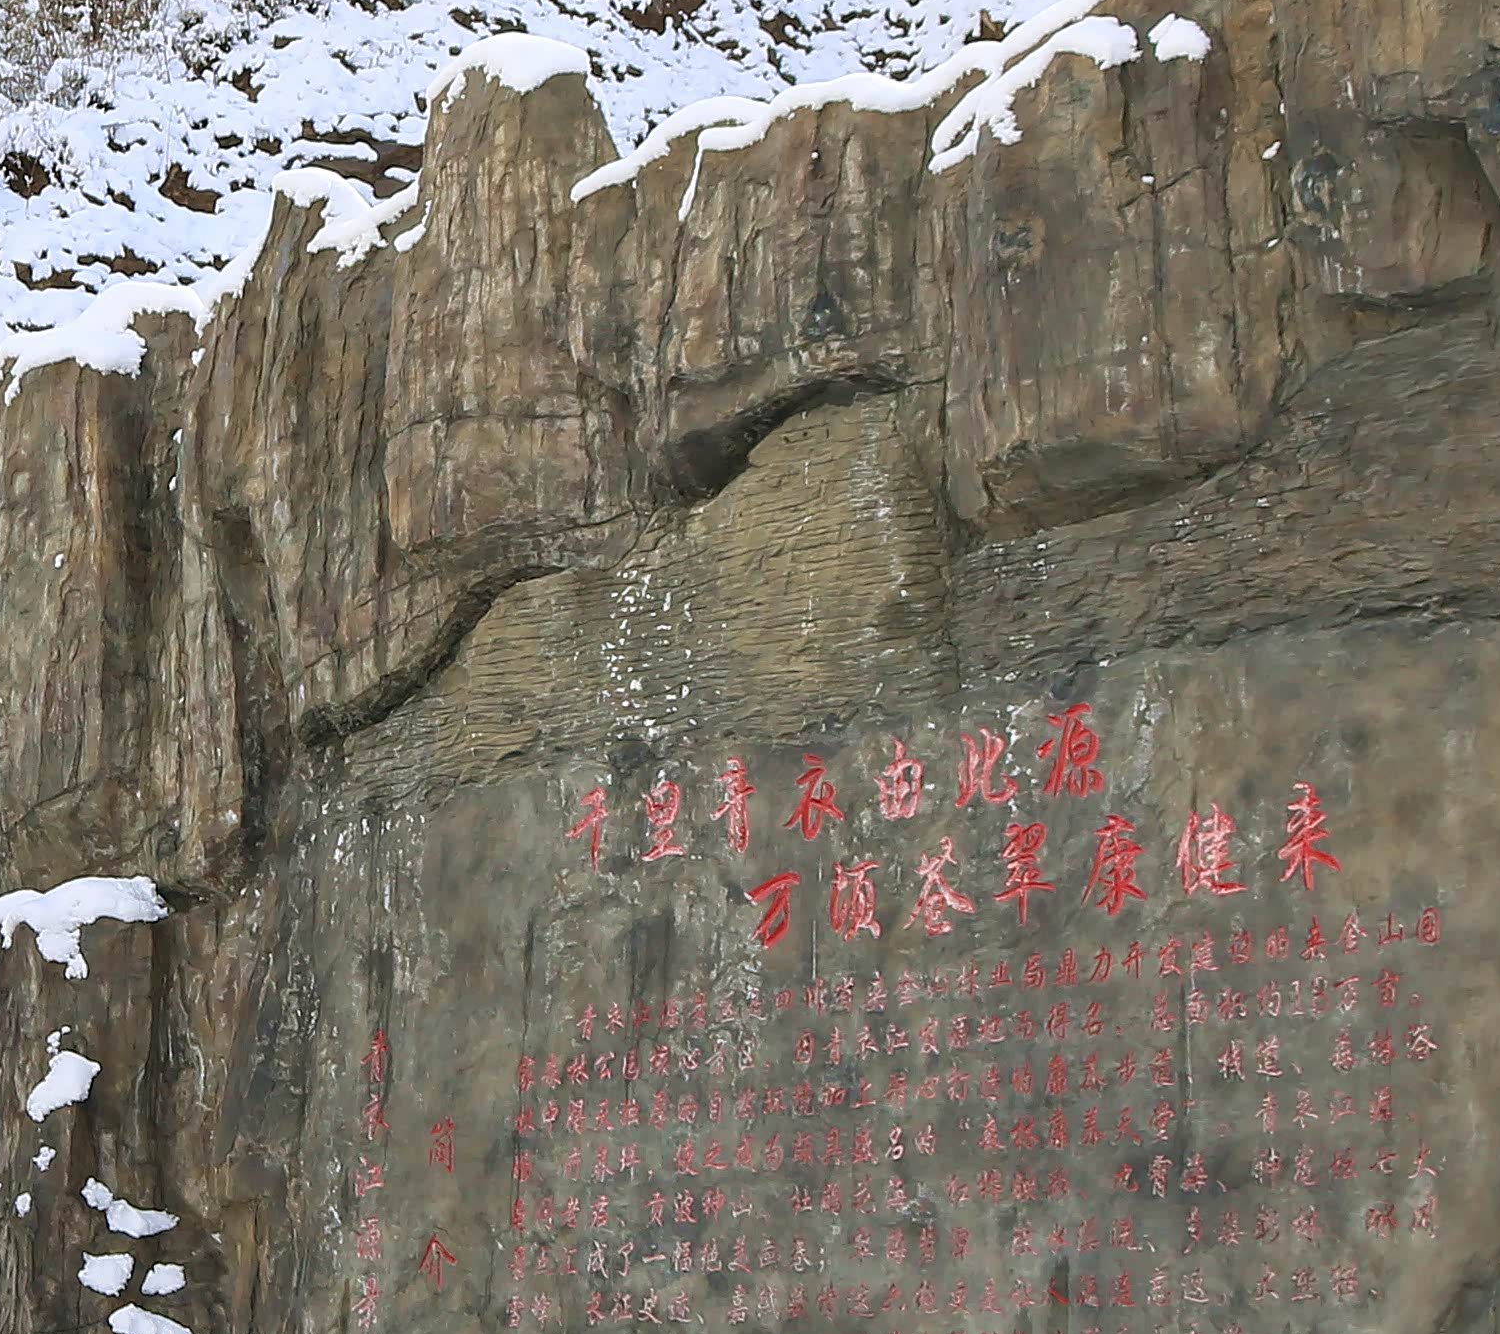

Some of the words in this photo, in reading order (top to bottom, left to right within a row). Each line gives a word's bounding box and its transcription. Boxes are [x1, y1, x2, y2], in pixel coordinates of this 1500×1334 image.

[566, 701, 1105, 869] 千里青衣由此源
[744, 780, 1344, 952] 万顷苍翠康健来
[418, 1116, 458, 1290] 简介
